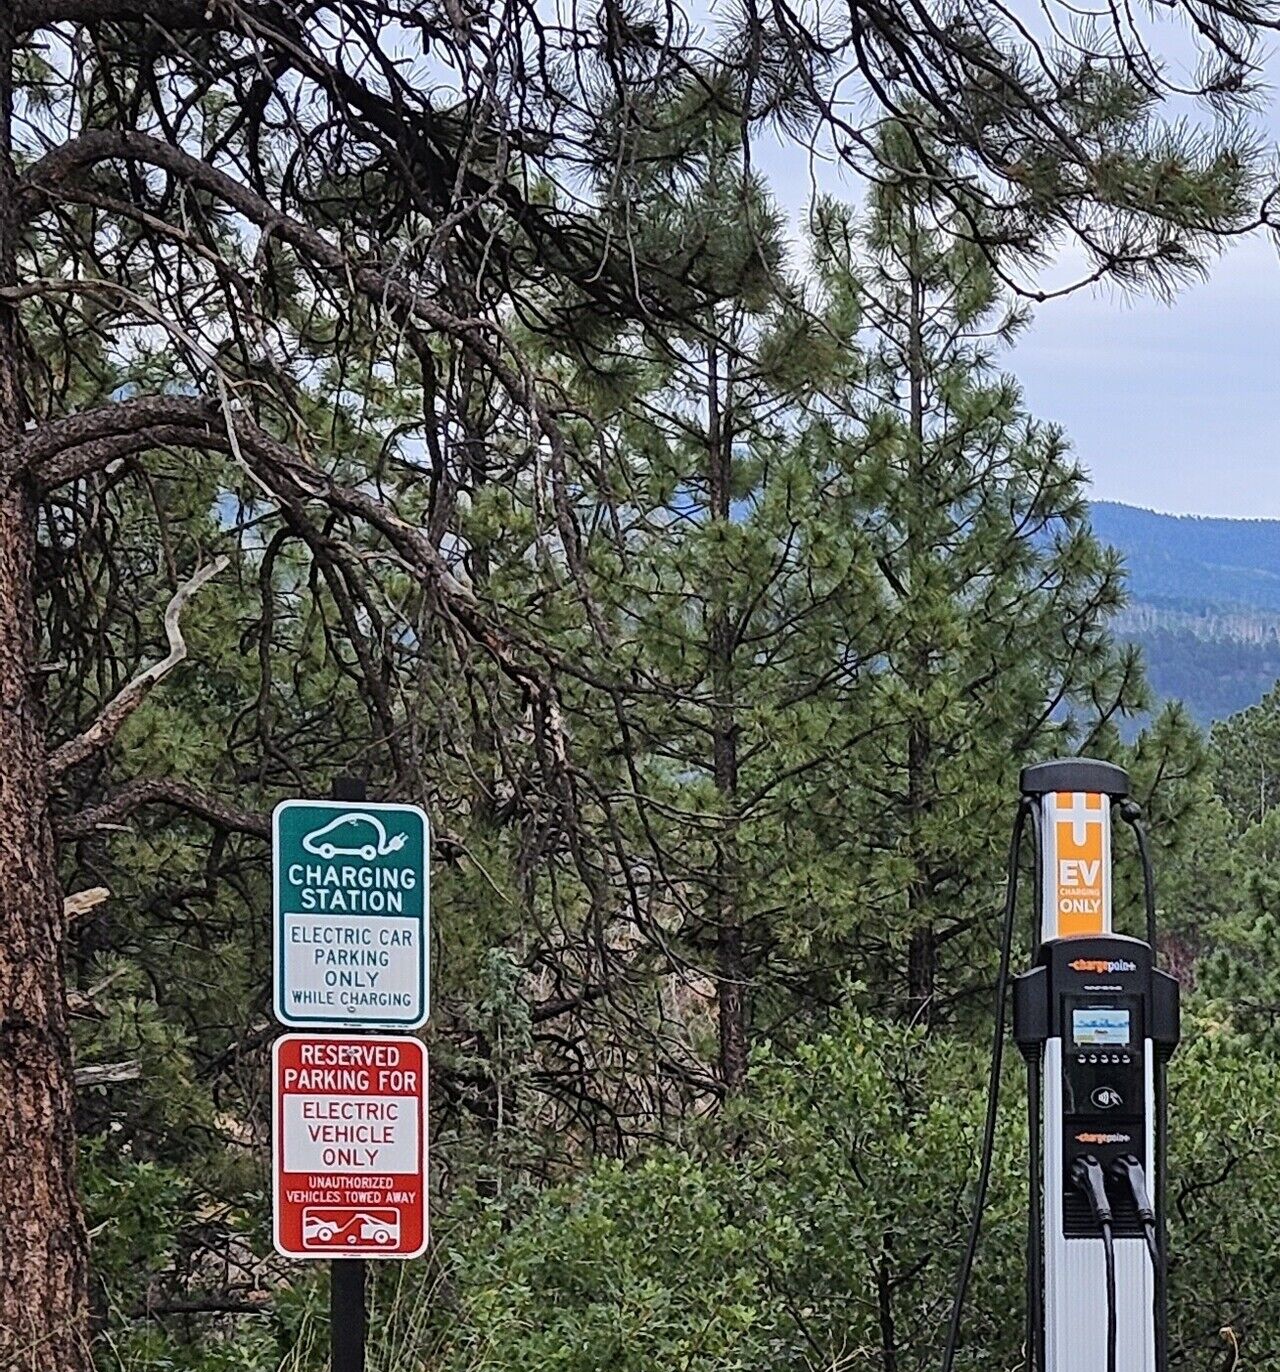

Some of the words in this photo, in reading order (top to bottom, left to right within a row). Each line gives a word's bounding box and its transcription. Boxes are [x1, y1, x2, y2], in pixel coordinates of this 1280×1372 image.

[288, 864, 416, 889] CHARGING
[1059, 859, 1100, 886] EV
[301, 888, 403, 912] STATION
[1059, 888, 1100, 896] CHARGING
[1059, 899, 1101, 914] ONLY
[291, 926, 372, 945] ELECTRIC
[379, 929, 413, 947] CAR
[314, 949, 389, 966] PARKING
[325, 970, 379, 987] ONLY
[292, 990, 334, 1005] WHILE
[340, 991, 411, 1007] CHARGING
[300, 1044, 400, 1067] RESERVED
[284, 1068, 369, 1091] PARKING
[378, 1070, 417, 1092] FOR
[303, 1101, 399, 1120] ELECTRIC
[308, 1125, 395, 1144] VEHICLE
[322, 1148, 379, 1166] ONLY
[308, 1176, 394, 1190] UNAUTHORIZED
[286, 1190, 341, 1203] VEHICLES
[345, 1191, 381, 1204] TOWED
[385, 1191, 416, 1204] AWAY
